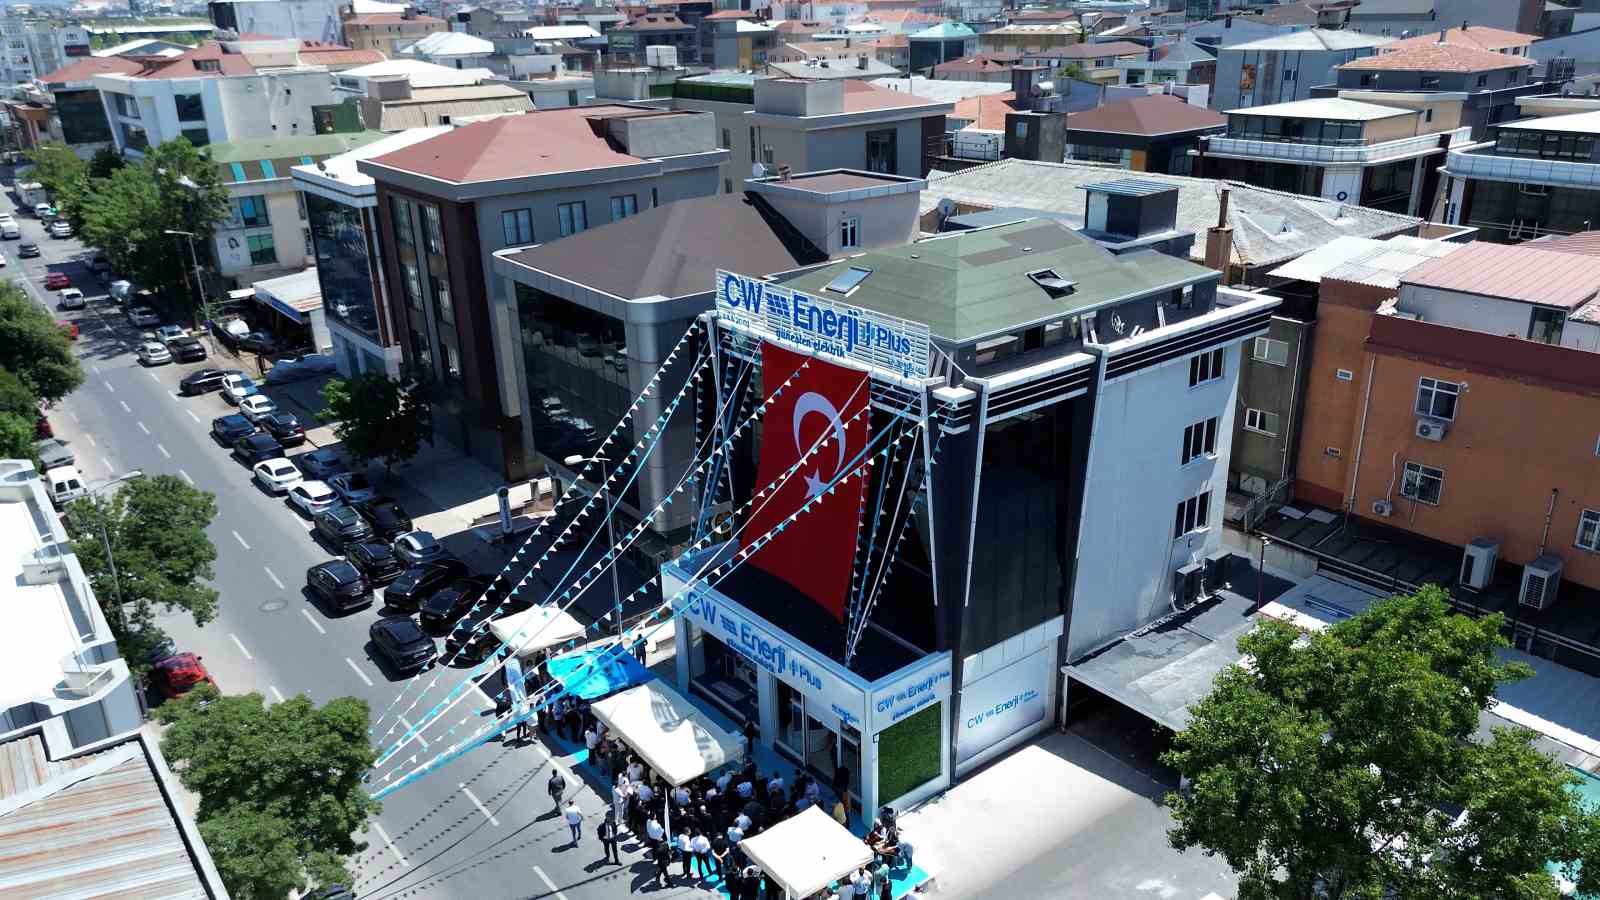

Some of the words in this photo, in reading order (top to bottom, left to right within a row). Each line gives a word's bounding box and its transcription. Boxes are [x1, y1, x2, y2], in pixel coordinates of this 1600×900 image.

[724, 274, 763, 314] CW
[793, 293, 859, 353] Enerji
[876, 325, 912, 356] Plus
[687, 591, 717, 625] CW
[740, 622, 786, 674] Enerji
[967, 711, 984, 729] CW
[995, 694, 1019, 715] Enerji
